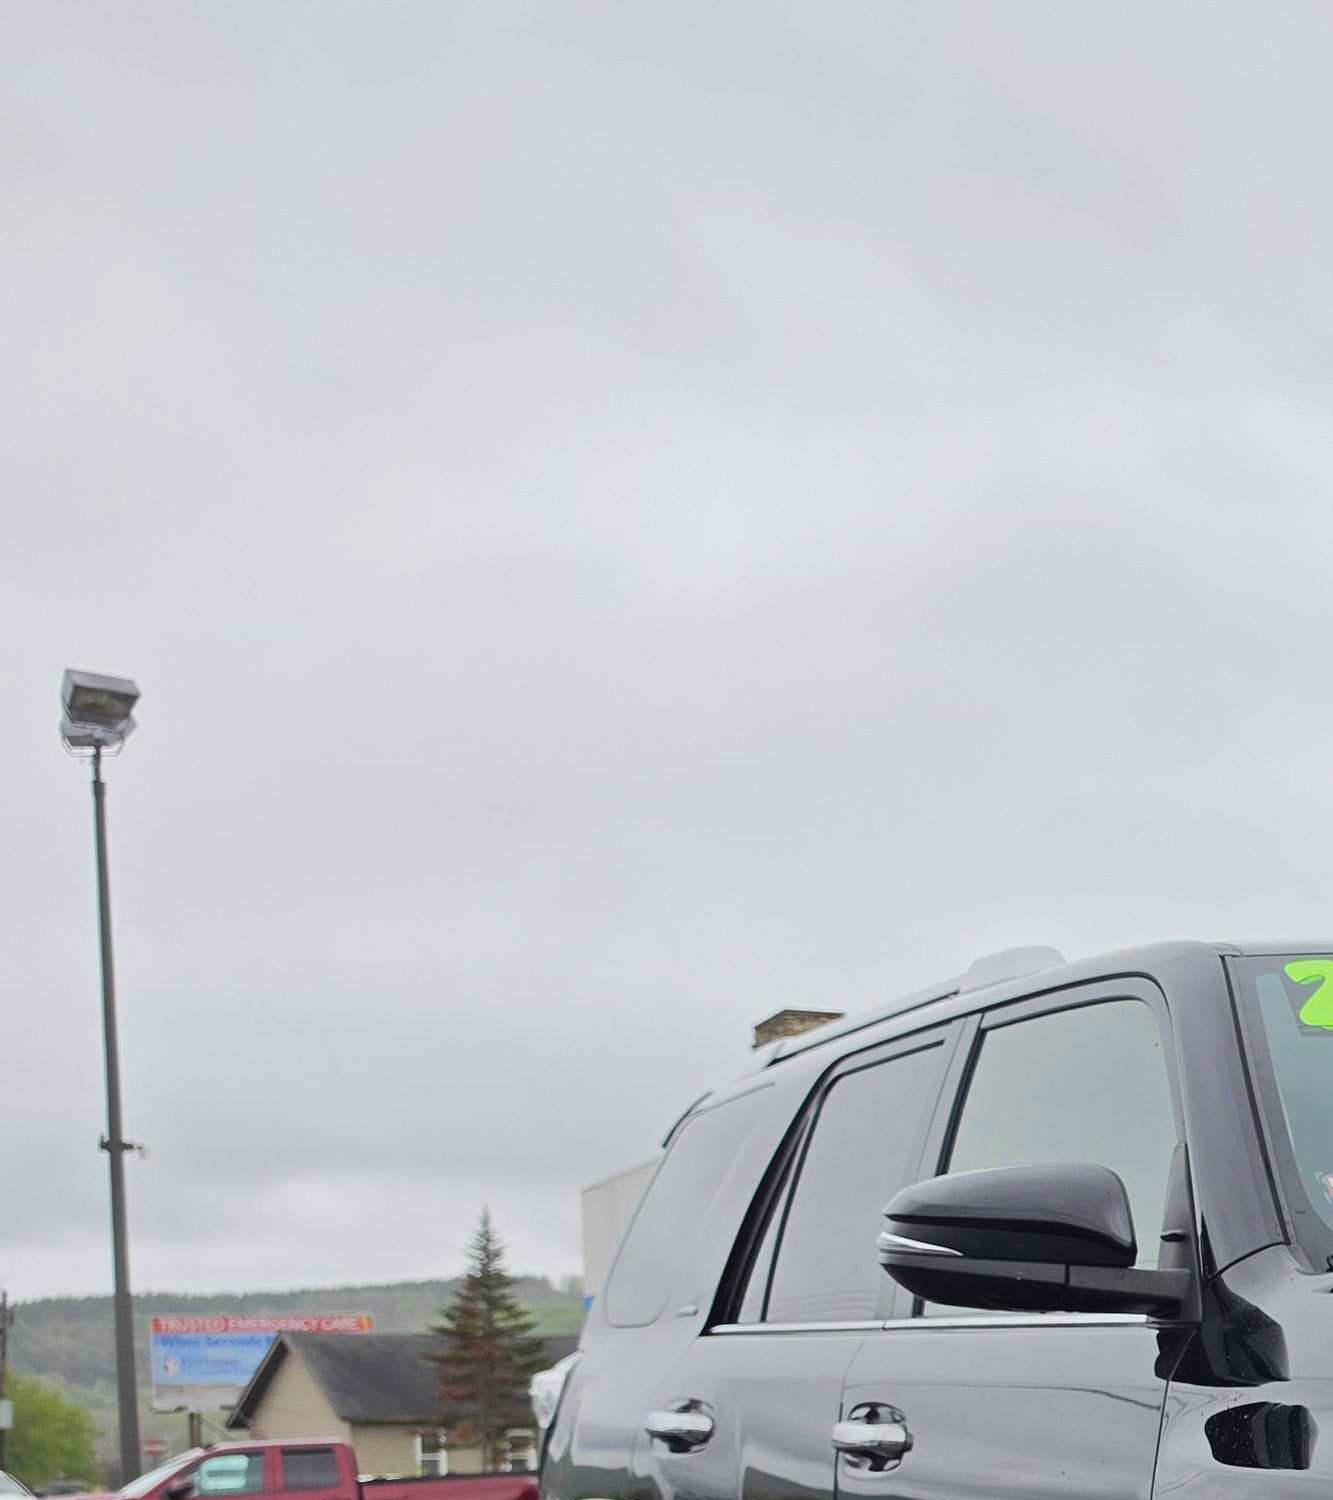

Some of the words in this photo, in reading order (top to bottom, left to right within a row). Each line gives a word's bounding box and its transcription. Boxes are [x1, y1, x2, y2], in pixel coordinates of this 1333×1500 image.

[158, 1316, 226, 1333] TRUSTED
[227, 1316, 319, 1332] EMERGENCY
[319, 1315, 360, 1332] CARE
